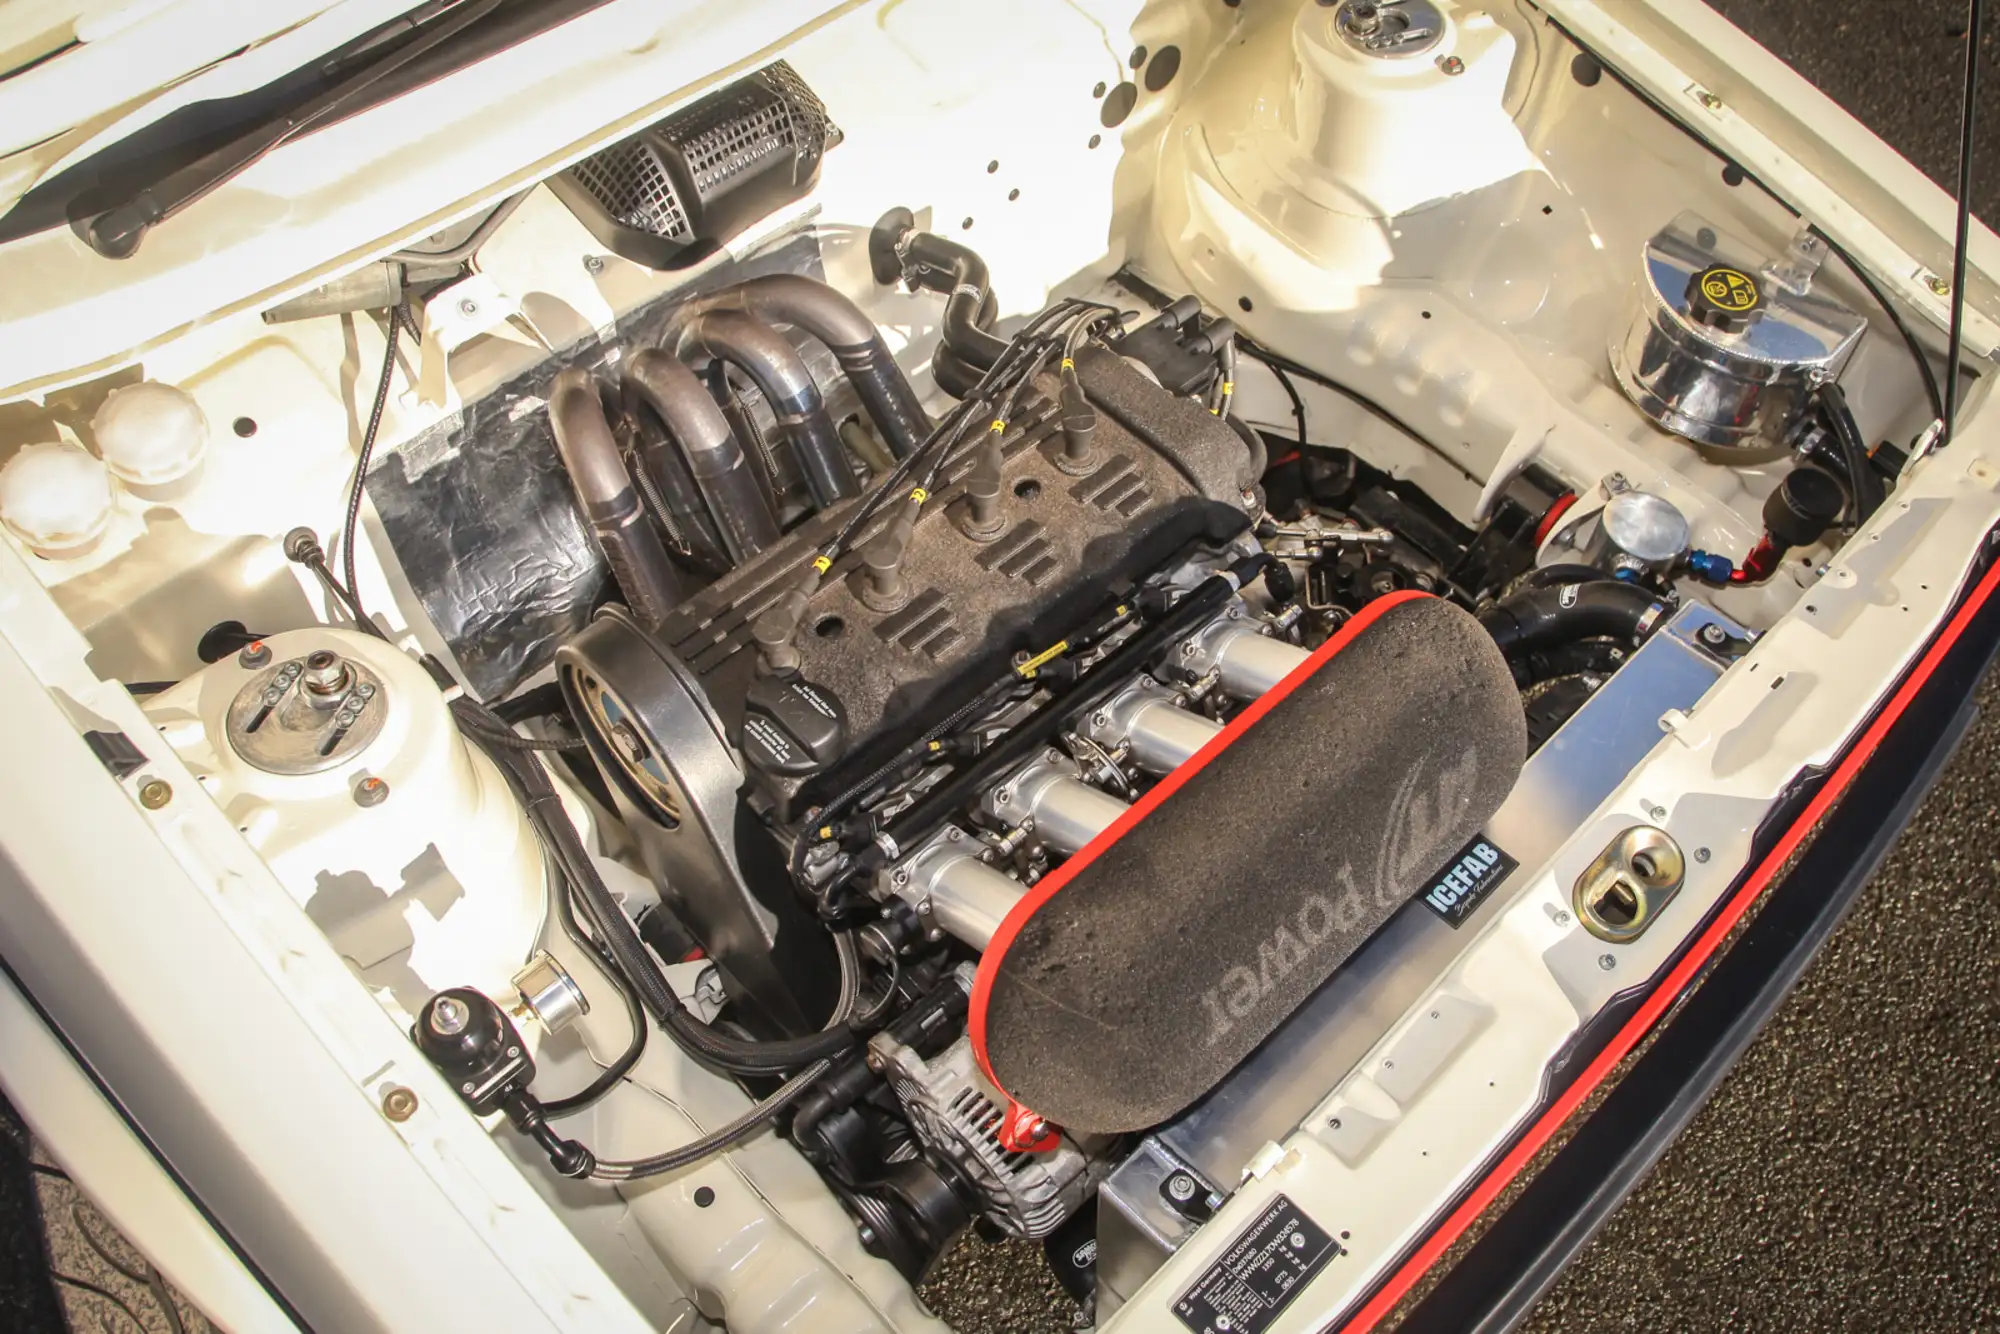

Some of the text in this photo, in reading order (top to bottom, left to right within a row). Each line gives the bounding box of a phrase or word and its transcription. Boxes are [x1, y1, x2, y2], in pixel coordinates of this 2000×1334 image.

[1425, 843, 1499, 913] ICEFAB
[1224, 1209, 1279, 1265] VOLKSWAGENWERK
[1277, 1199, 1288, 1211] AG
[1188, 1267, 1222, 1300] West Germany
